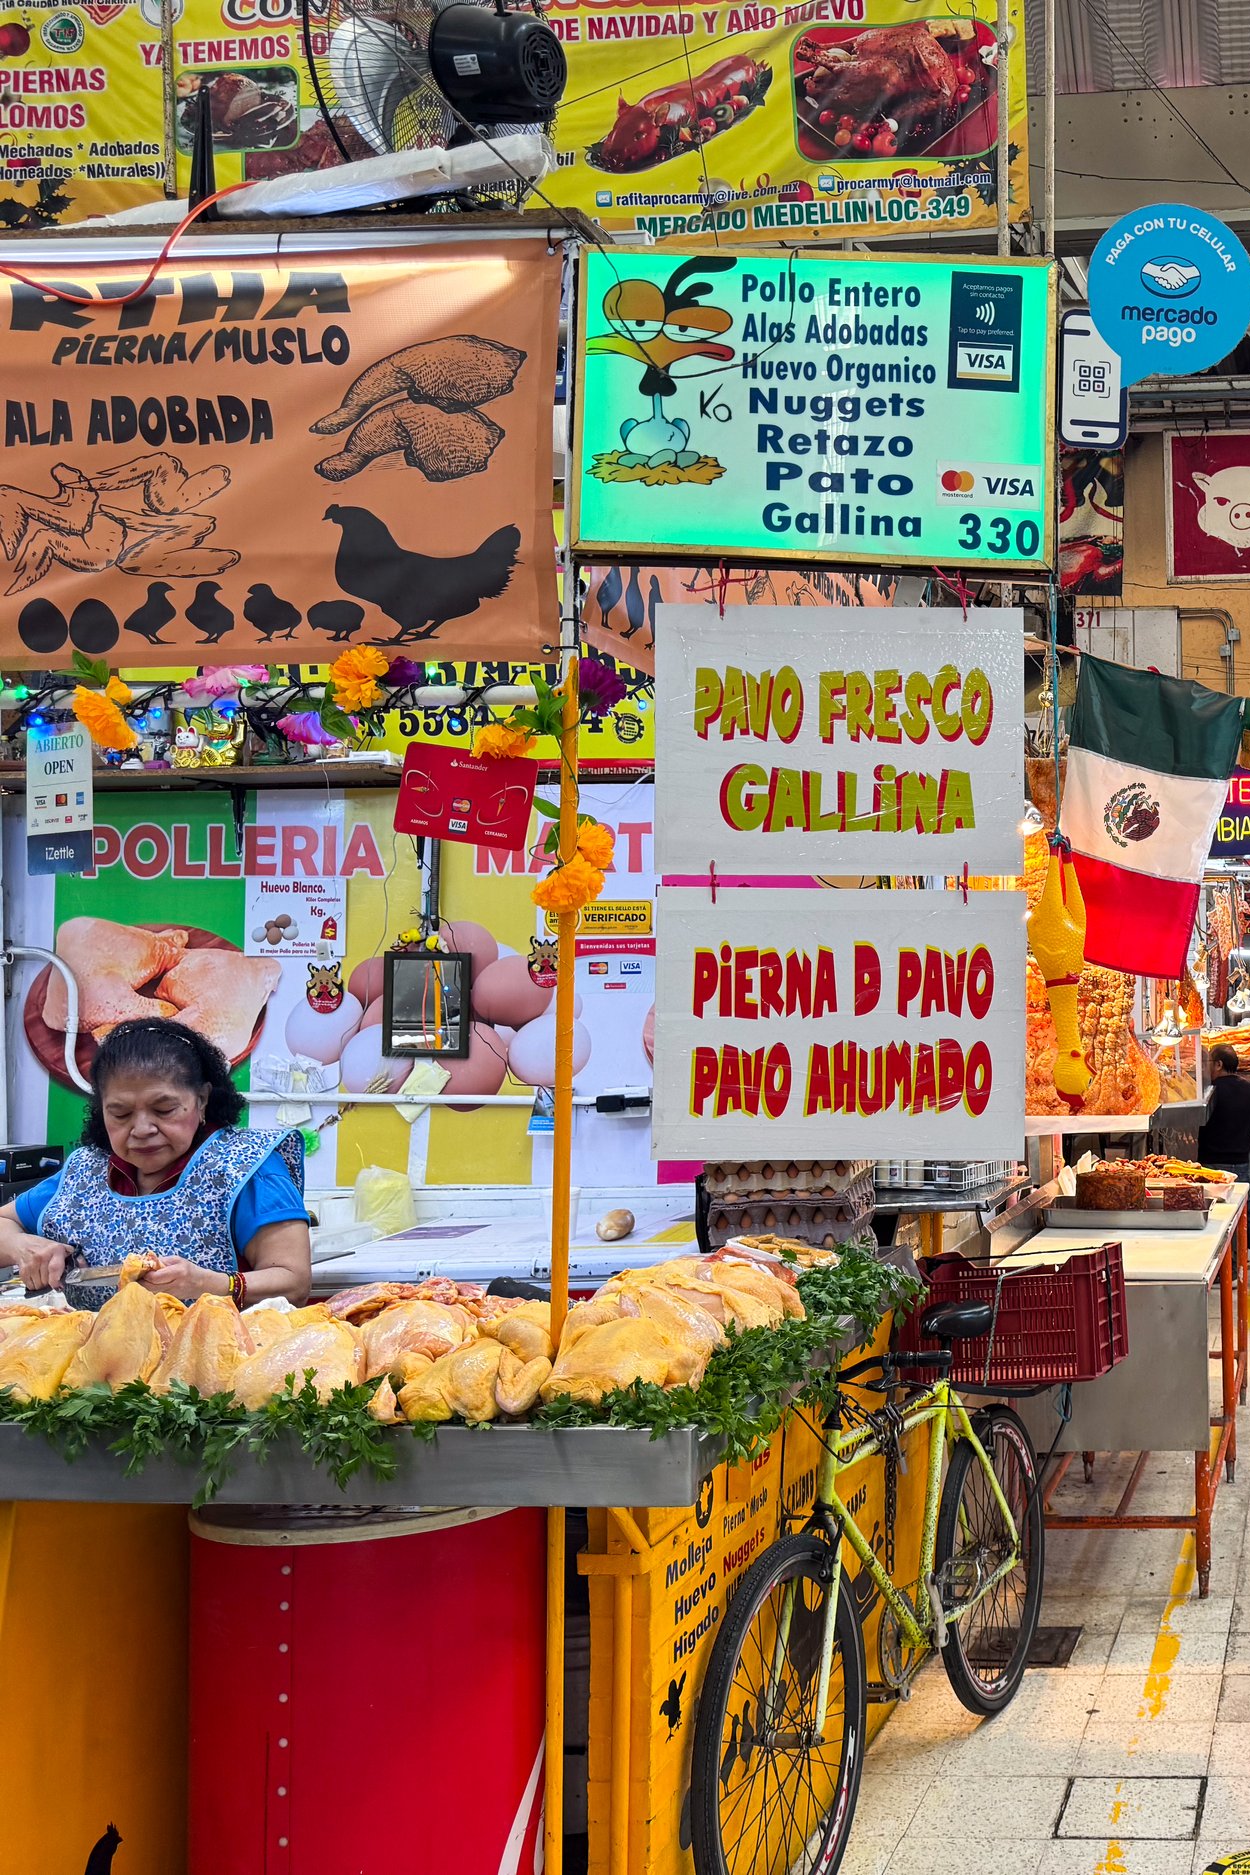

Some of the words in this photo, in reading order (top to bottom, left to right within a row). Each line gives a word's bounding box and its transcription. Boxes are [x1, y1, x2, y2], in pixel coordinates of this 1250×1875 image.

[552, 18, 579, 41] DE
[587, 10, 694, 41] NAVIDAD
[702, 10, 719, 34] Y
[727, 2, 779, 31] AÑO
[785, 0, 866, 24] NUEVO
[178, 36, 290, 65] TENEMOS
[0, 68, 105, 93] PIERNAS
[0, 103, 85, 129] LOMOS
[0, 143, 73, 158] Mechados
[89, 141, 160, 157] Adobados
[837, 172, 991, 194] procarmyr@hotmail.com
[636, 211, 746, 239] MERCADO
[754, 200, 871, 229] MEDELLIN
[874, 195, 970, 223] LOC.349
[1105, 232, 1135, 266] PAGA
[1134, 217, 1164, 236] CON
[1168, 217, 1187, 230] TU
[1189, 222, 1237, 273] CELULAR
[742, 274, 815, 304] Pollo
[828, 278, 921, 307] Entero
[962, 283, 995, 292] Aceptamos
[995, 286, 1014, 294] pagos
[742, 314, 796, 344] Alas
[805, 314, 928, 347] Adobadas
[958, 326, 968, 334] Tap
[1121, 305, 1218, 326] mercado
[1141, 325, 1196, 347] pago
[742, 353, 815, 381] Huevo
[827, 356, 936, 386] Organico
[964, 352, 1006, 370] VISA
[87, 396, 274, 447] ADOBADA
[749, 387, 925, 423] Nuggets
[4, 400, 73, 447] ALA
[757, 424, 914, 458] Retazo
[765, 462, 914, 496] Pato
[942, 491, 974, 499] mastercard
[983, 476, 1036, 497] VISA
[762, 502, 922, 538] Gallina
[958, 513, 1040, 557] 330
[693, 665, 804, 744] PAVO
[818, 664, 994, 746] FRESCO
[35, 733, 84, 753] ABIERTO
[44, 759, 75, 776] OPEN
[458, 760, 489, 772] Santander
[450, 820, 467, 830] VISA
[45, 845, 75, 860] iZettle
[83, 824, 385, 877] POLLERIA
[261, 881, 290, 893] Huevo
[292, 881, 326, 894] Blanco.
[310, 906, 326, 917] Kg.
[584, 913, 647, 922] VERIFICADO
[623, 962, 641, 970] VISA
[853, 940, 882, 1017] D
[897, 943, 995, 1020] PAVO
[689, 1042, 793, 1120] PAVO
[803, 1038, 993, 1119] AHUMADO
[723, 1509, 746, 1537] Pierna
[750, 1486, 768, 1518] Muslo
[665, 1531, 713, 1590] Molleja
[723, 1527, 765, 1577] Nuggets
[674, 1571, 717, 1626] Huevo
[673, 1604, 719, 1664] Higado
